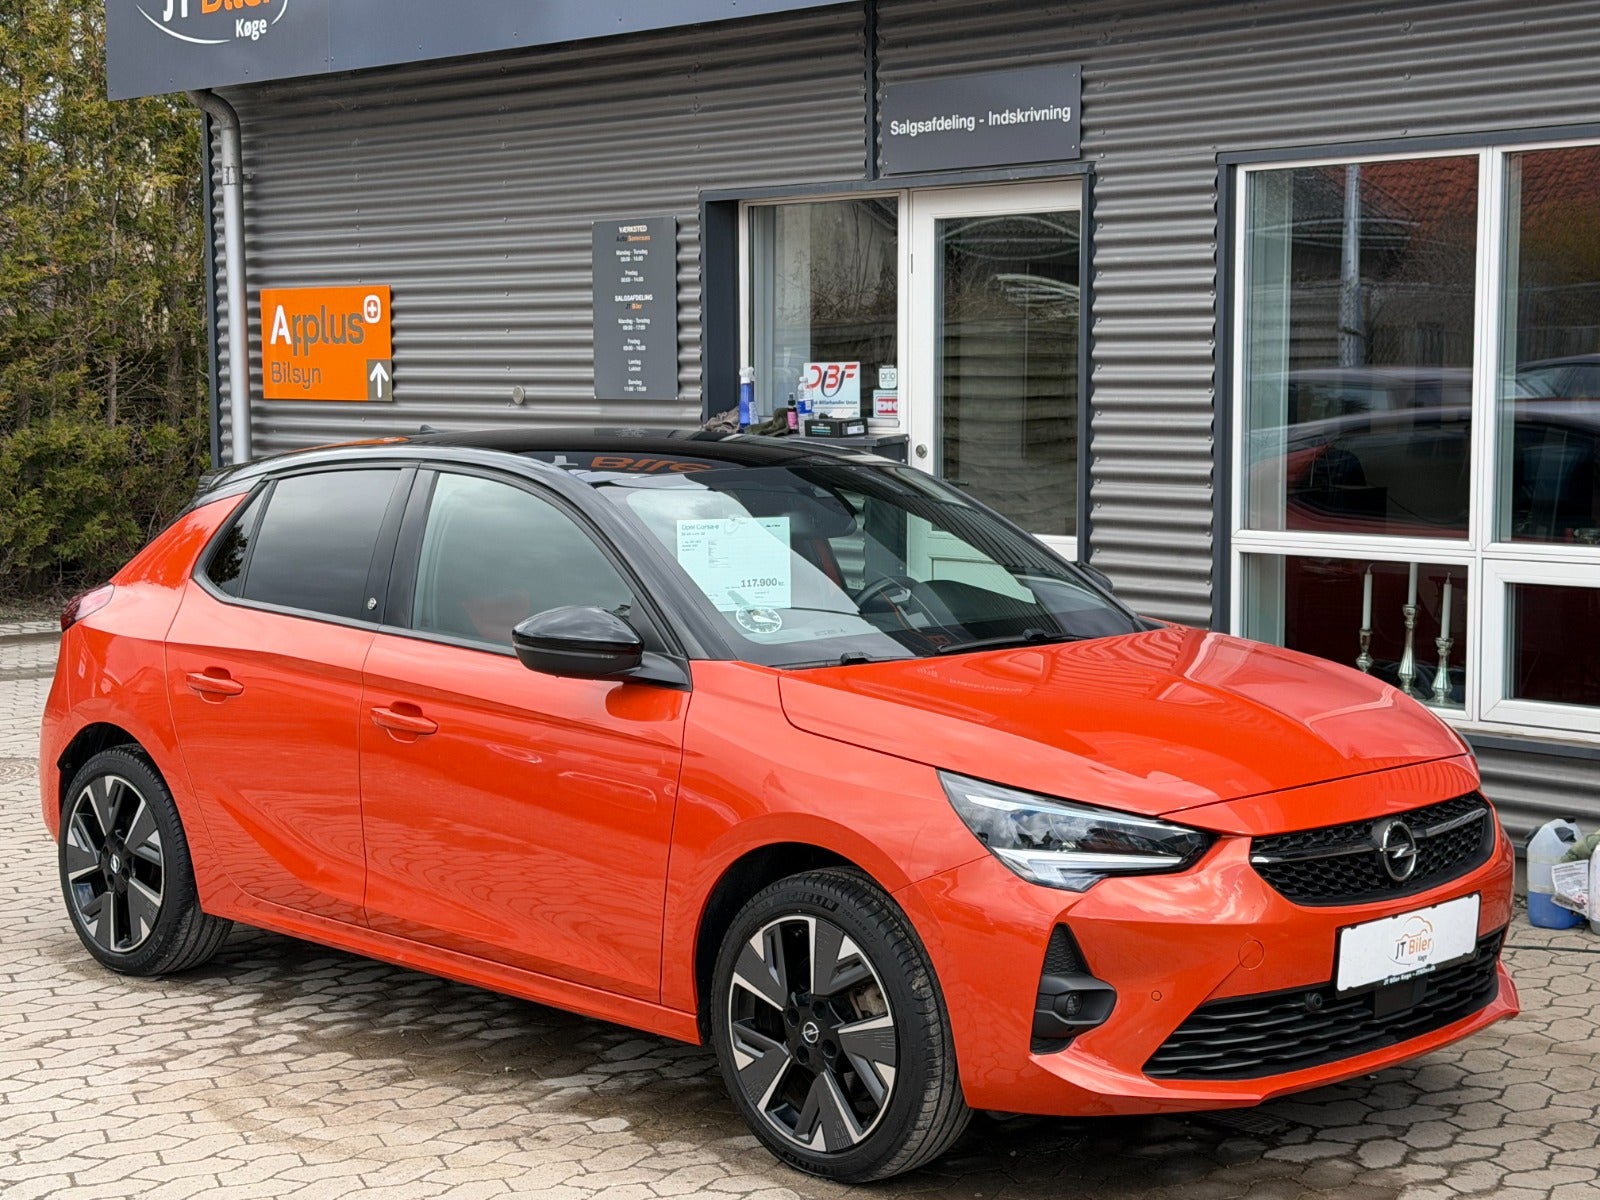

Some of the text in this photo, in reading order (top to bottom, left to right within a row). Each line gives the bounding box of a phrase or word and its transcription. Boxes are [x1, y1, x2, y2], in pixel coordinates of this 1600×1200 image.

[236, 18, 267, 41] Køge
[890, 114, 976, 137] Salgsafdeling
[988, 105, 1071, 126] Indskrivning
[271, 361, 321, 390] Bilsyn
[740, 577, 778, 588] 117.900
[1395, 937, 1431, 960] JT Biler
